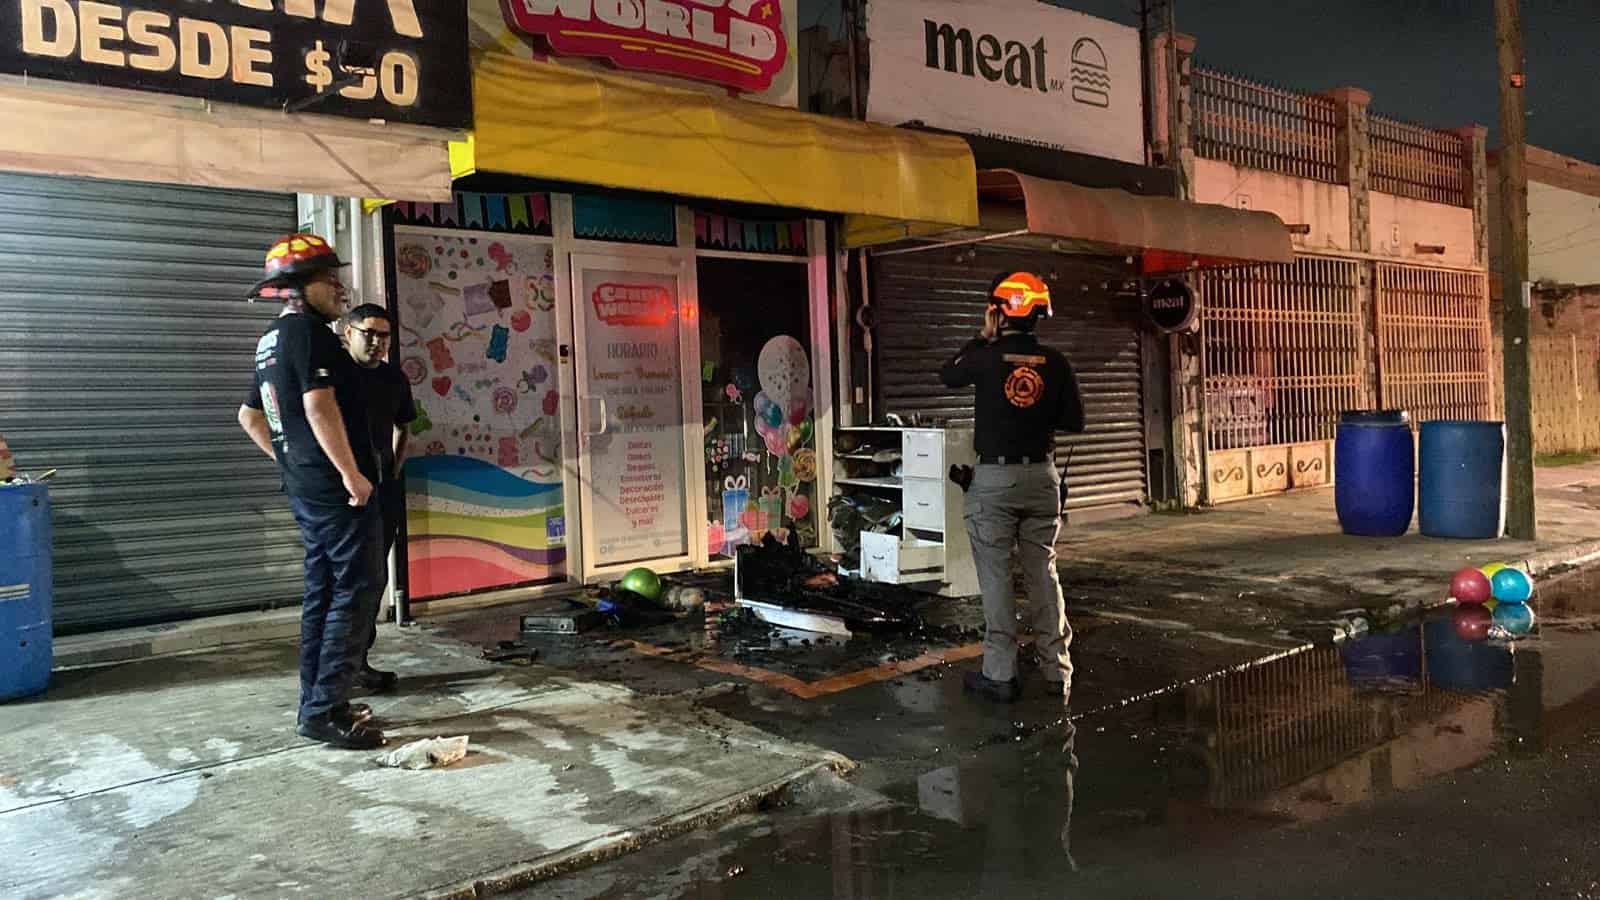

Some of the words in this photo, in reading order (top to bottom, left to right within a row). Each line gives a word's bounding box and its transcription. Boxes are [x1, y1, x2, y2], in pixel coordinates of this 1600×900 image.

[20, 0, 273, 87] DESDE
[924, 18, 1049, 93] meat
[1051, 78, 1065, 93] MX
[607, 343, 658, 360] HORARIO
